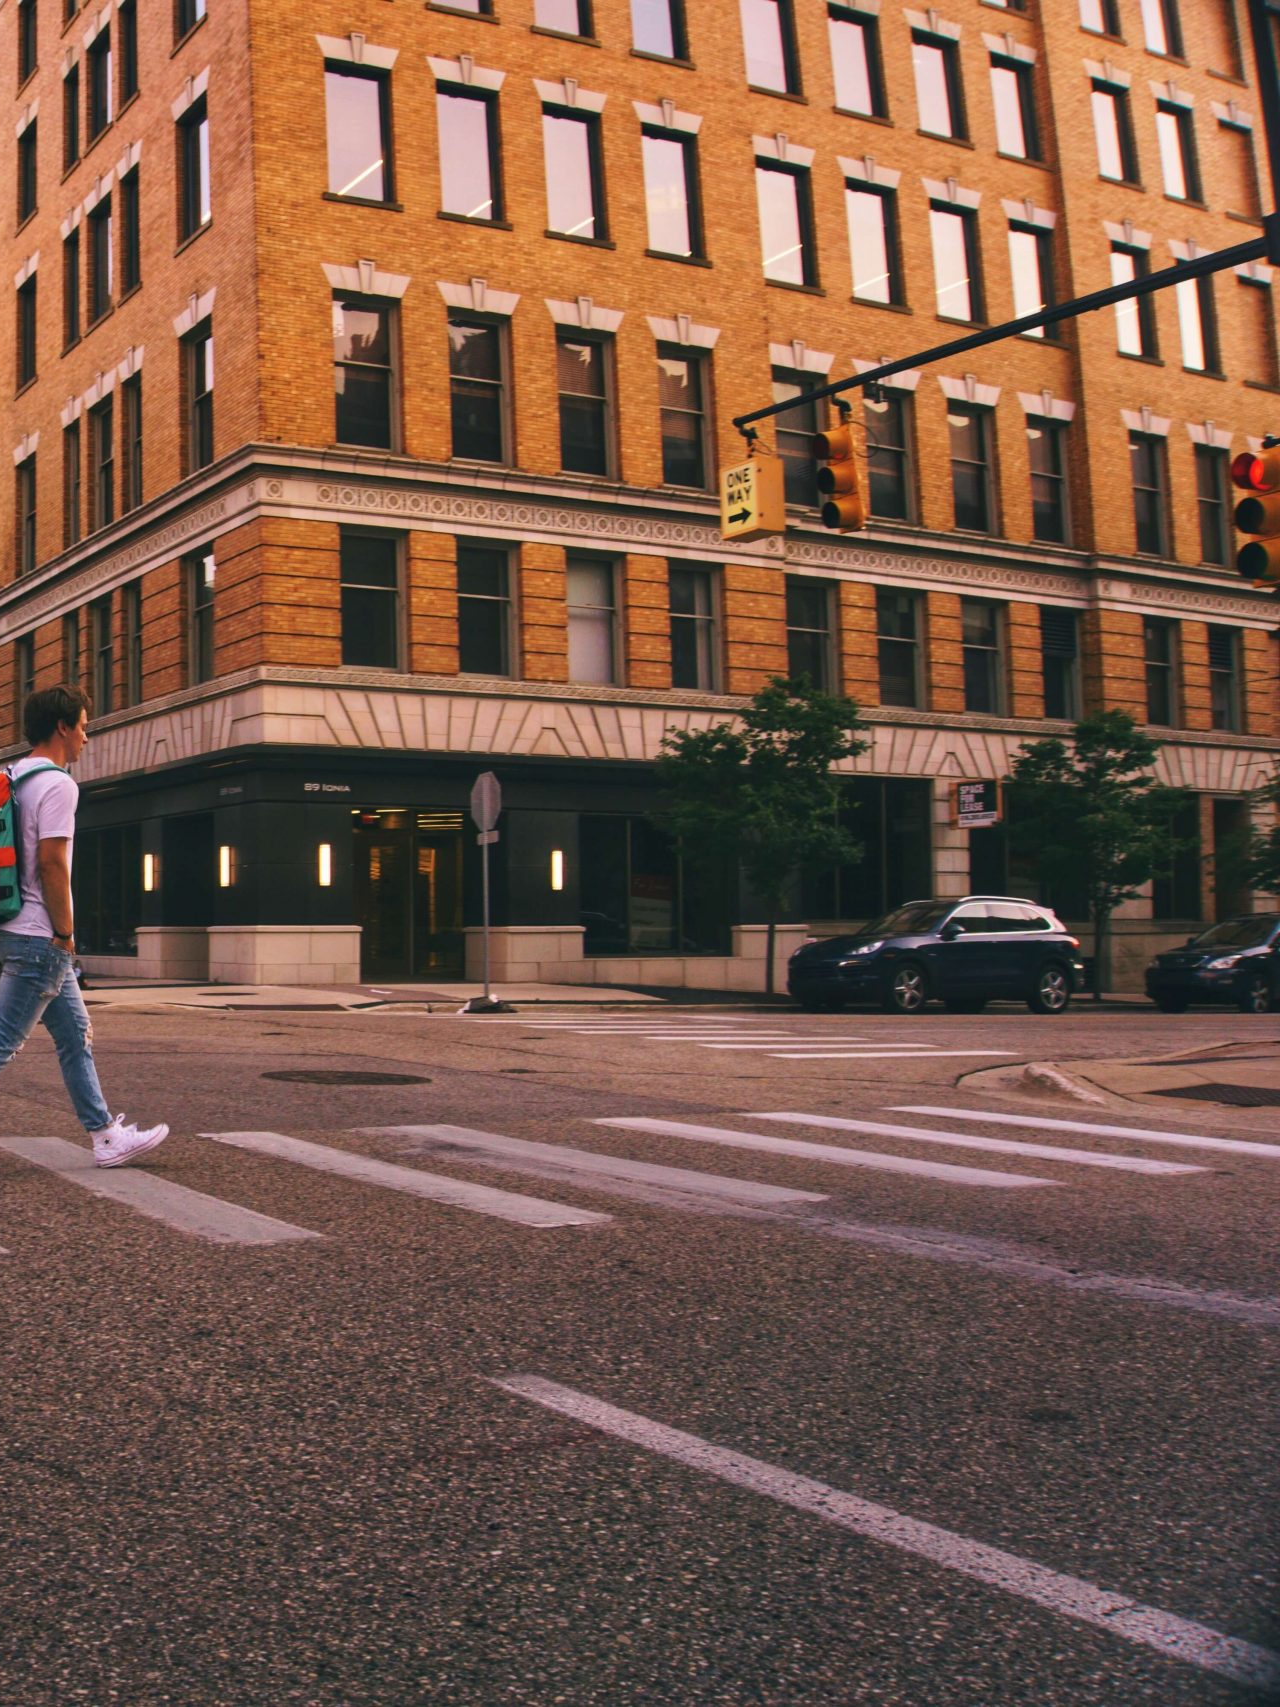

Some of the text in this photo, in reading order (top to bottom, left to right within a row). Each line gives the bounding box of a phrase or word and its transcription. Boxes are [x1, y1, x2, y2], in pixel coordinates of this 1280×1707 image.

[727, 467, 750, 488] ONE
[727, 485, 752, 506] WAY
[304, 782, 320, 791] 89
[960, 784, 985, 794] SPACE
[960, 793, 976, 803] FOR
[960, 802, 985, 812] LEASE
